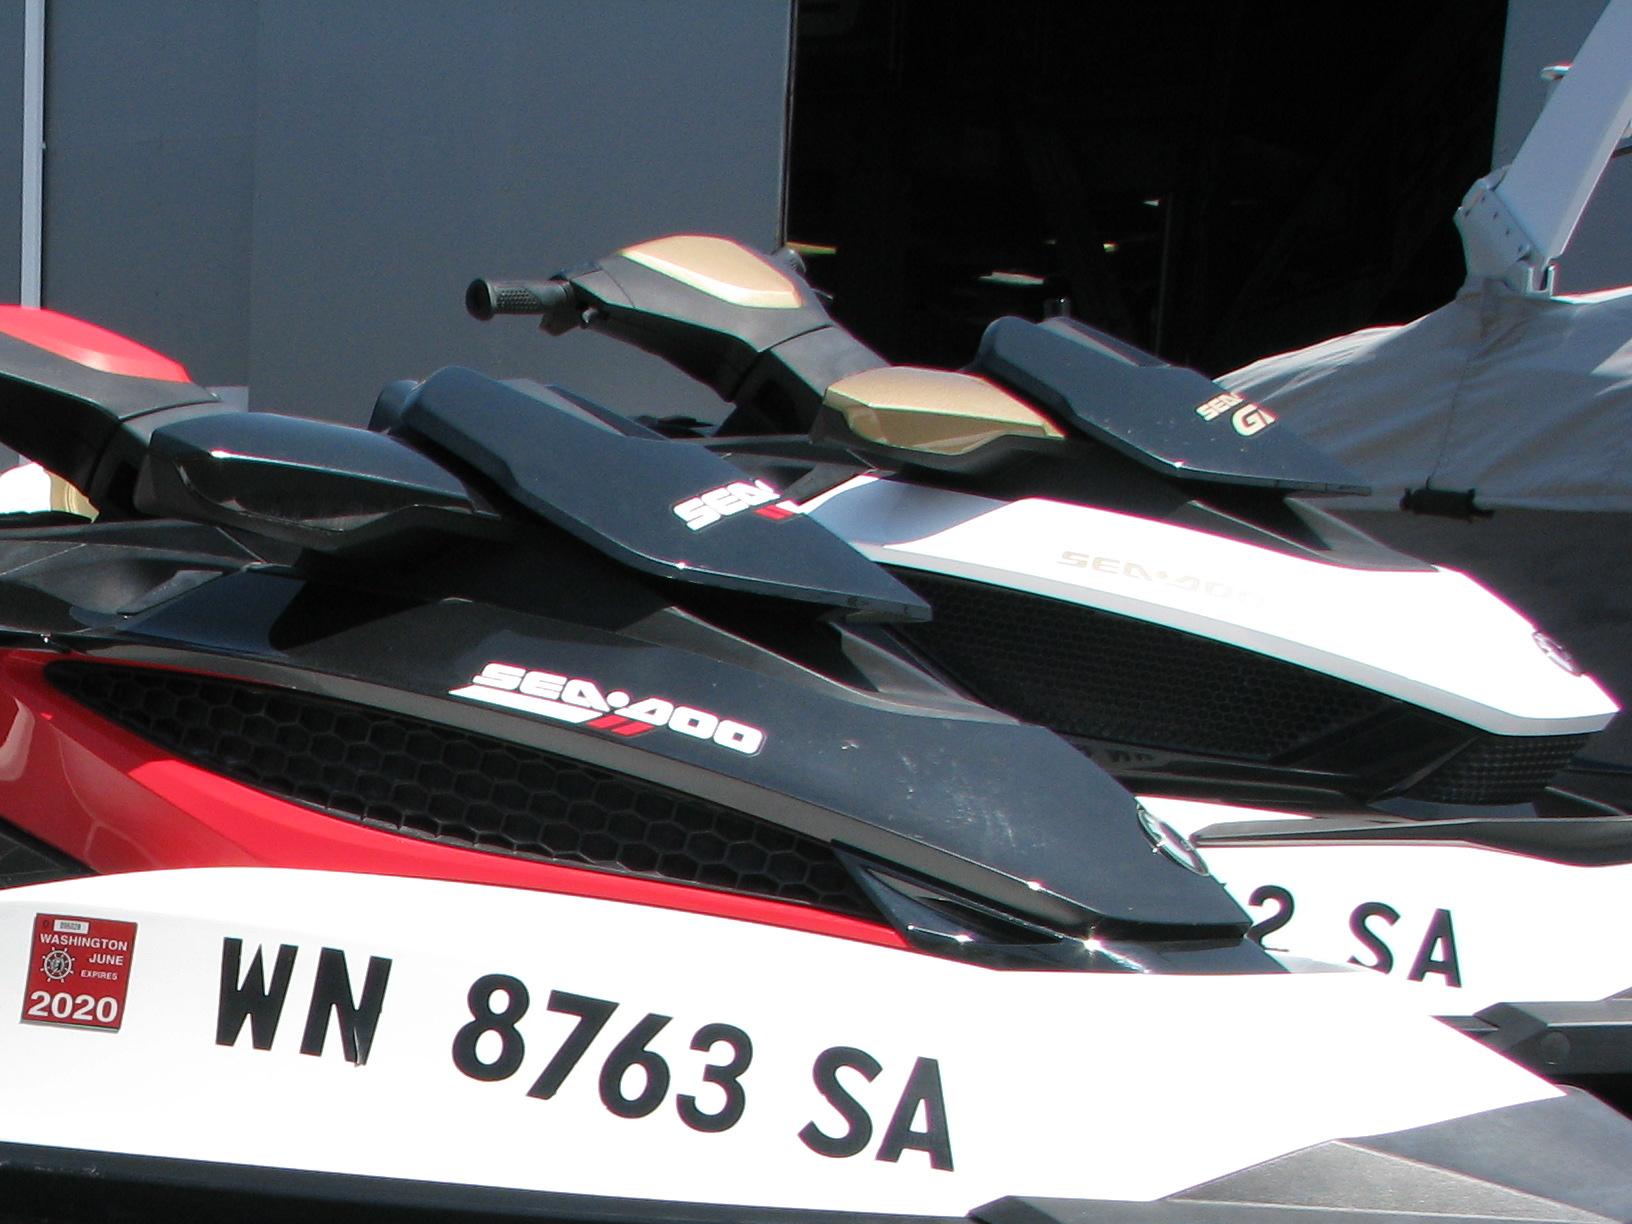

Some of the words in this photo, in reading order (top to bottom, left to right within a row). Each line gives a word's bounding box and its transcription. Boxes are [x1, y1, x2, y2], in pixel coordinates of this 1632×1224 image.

[40, 933, 128, 951] WASHINGTON
[1347, 901, 1462, 988] SA
[88, 953, 124, 966] JUNE
[80, 969, 118, 981] EXPIRES
[27, 990, 118, 1023] 2020
[215, 936, 392, 1067] WN
[451, 973, 754, 1133] 8763
[797, 1046, 955, 1172] SA
